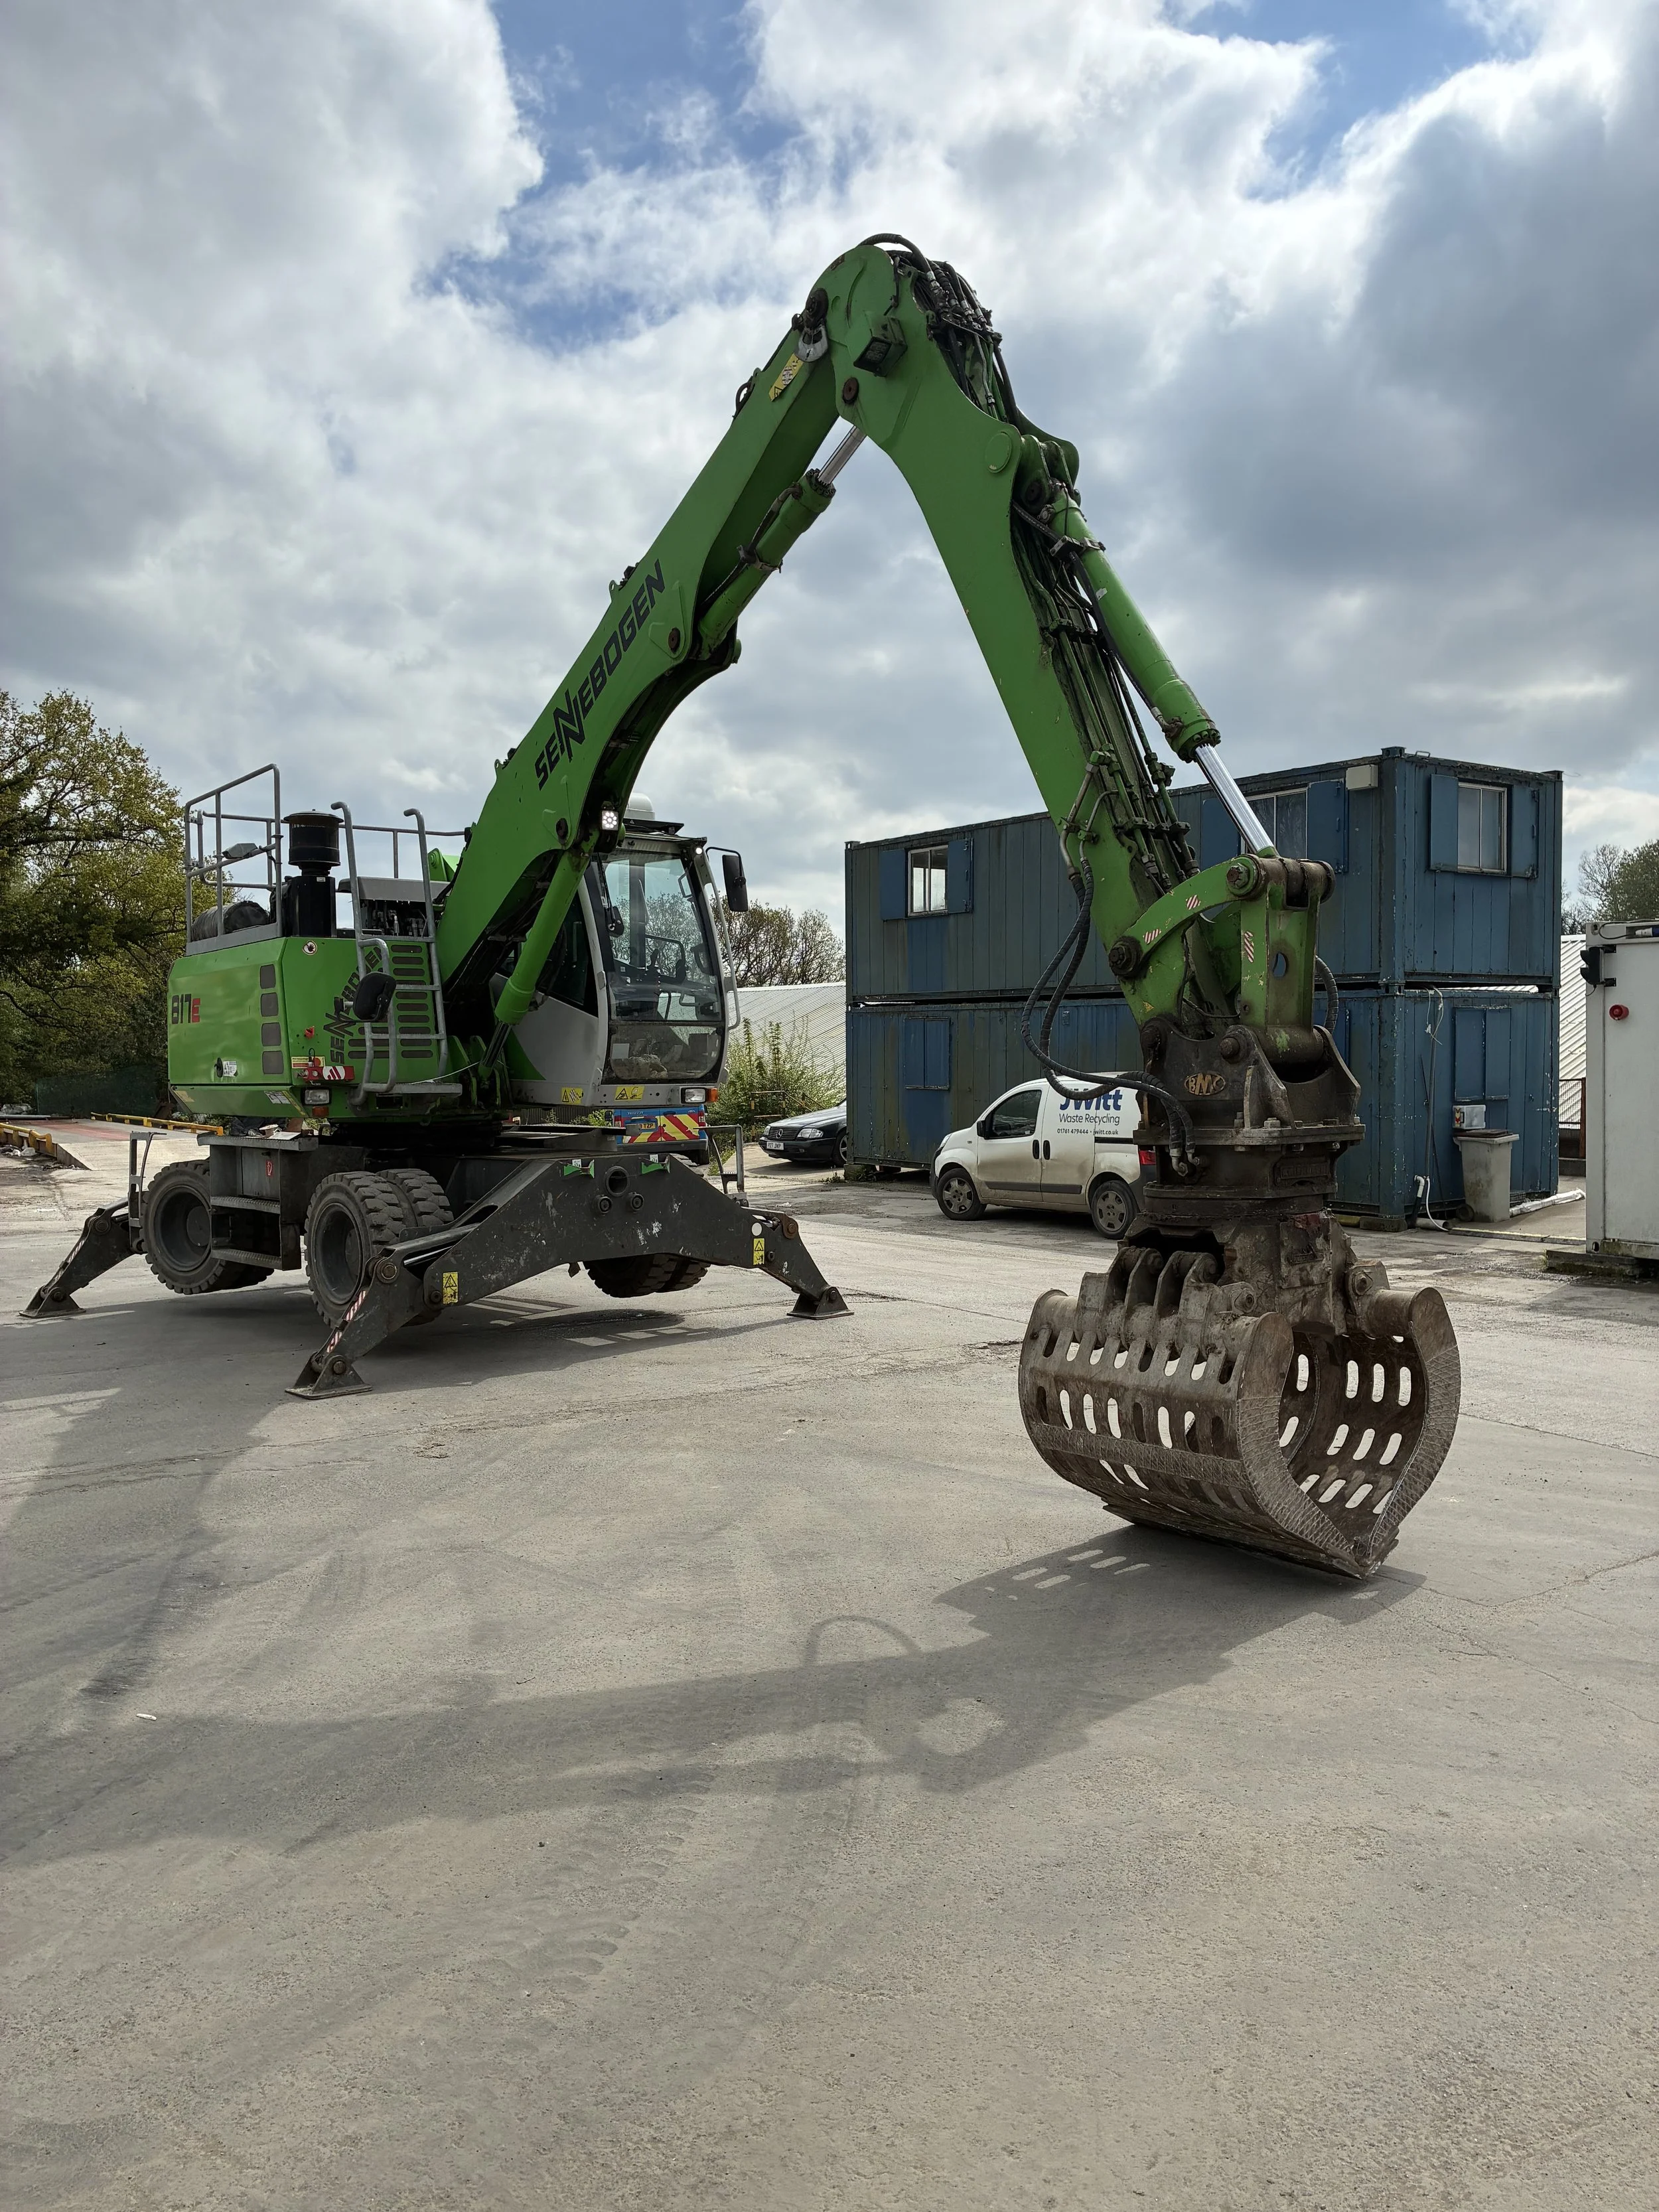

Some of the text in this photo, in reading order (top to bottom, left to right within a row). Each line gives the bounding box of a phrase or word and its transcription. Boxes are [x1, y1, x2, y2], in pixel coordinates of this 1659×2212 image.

[534, 559, 666, 790] SENNEBOGEN
[172, 994, 200, 1024] 817E
[1059, 1114, 1120, 1126] Waste Recycling
